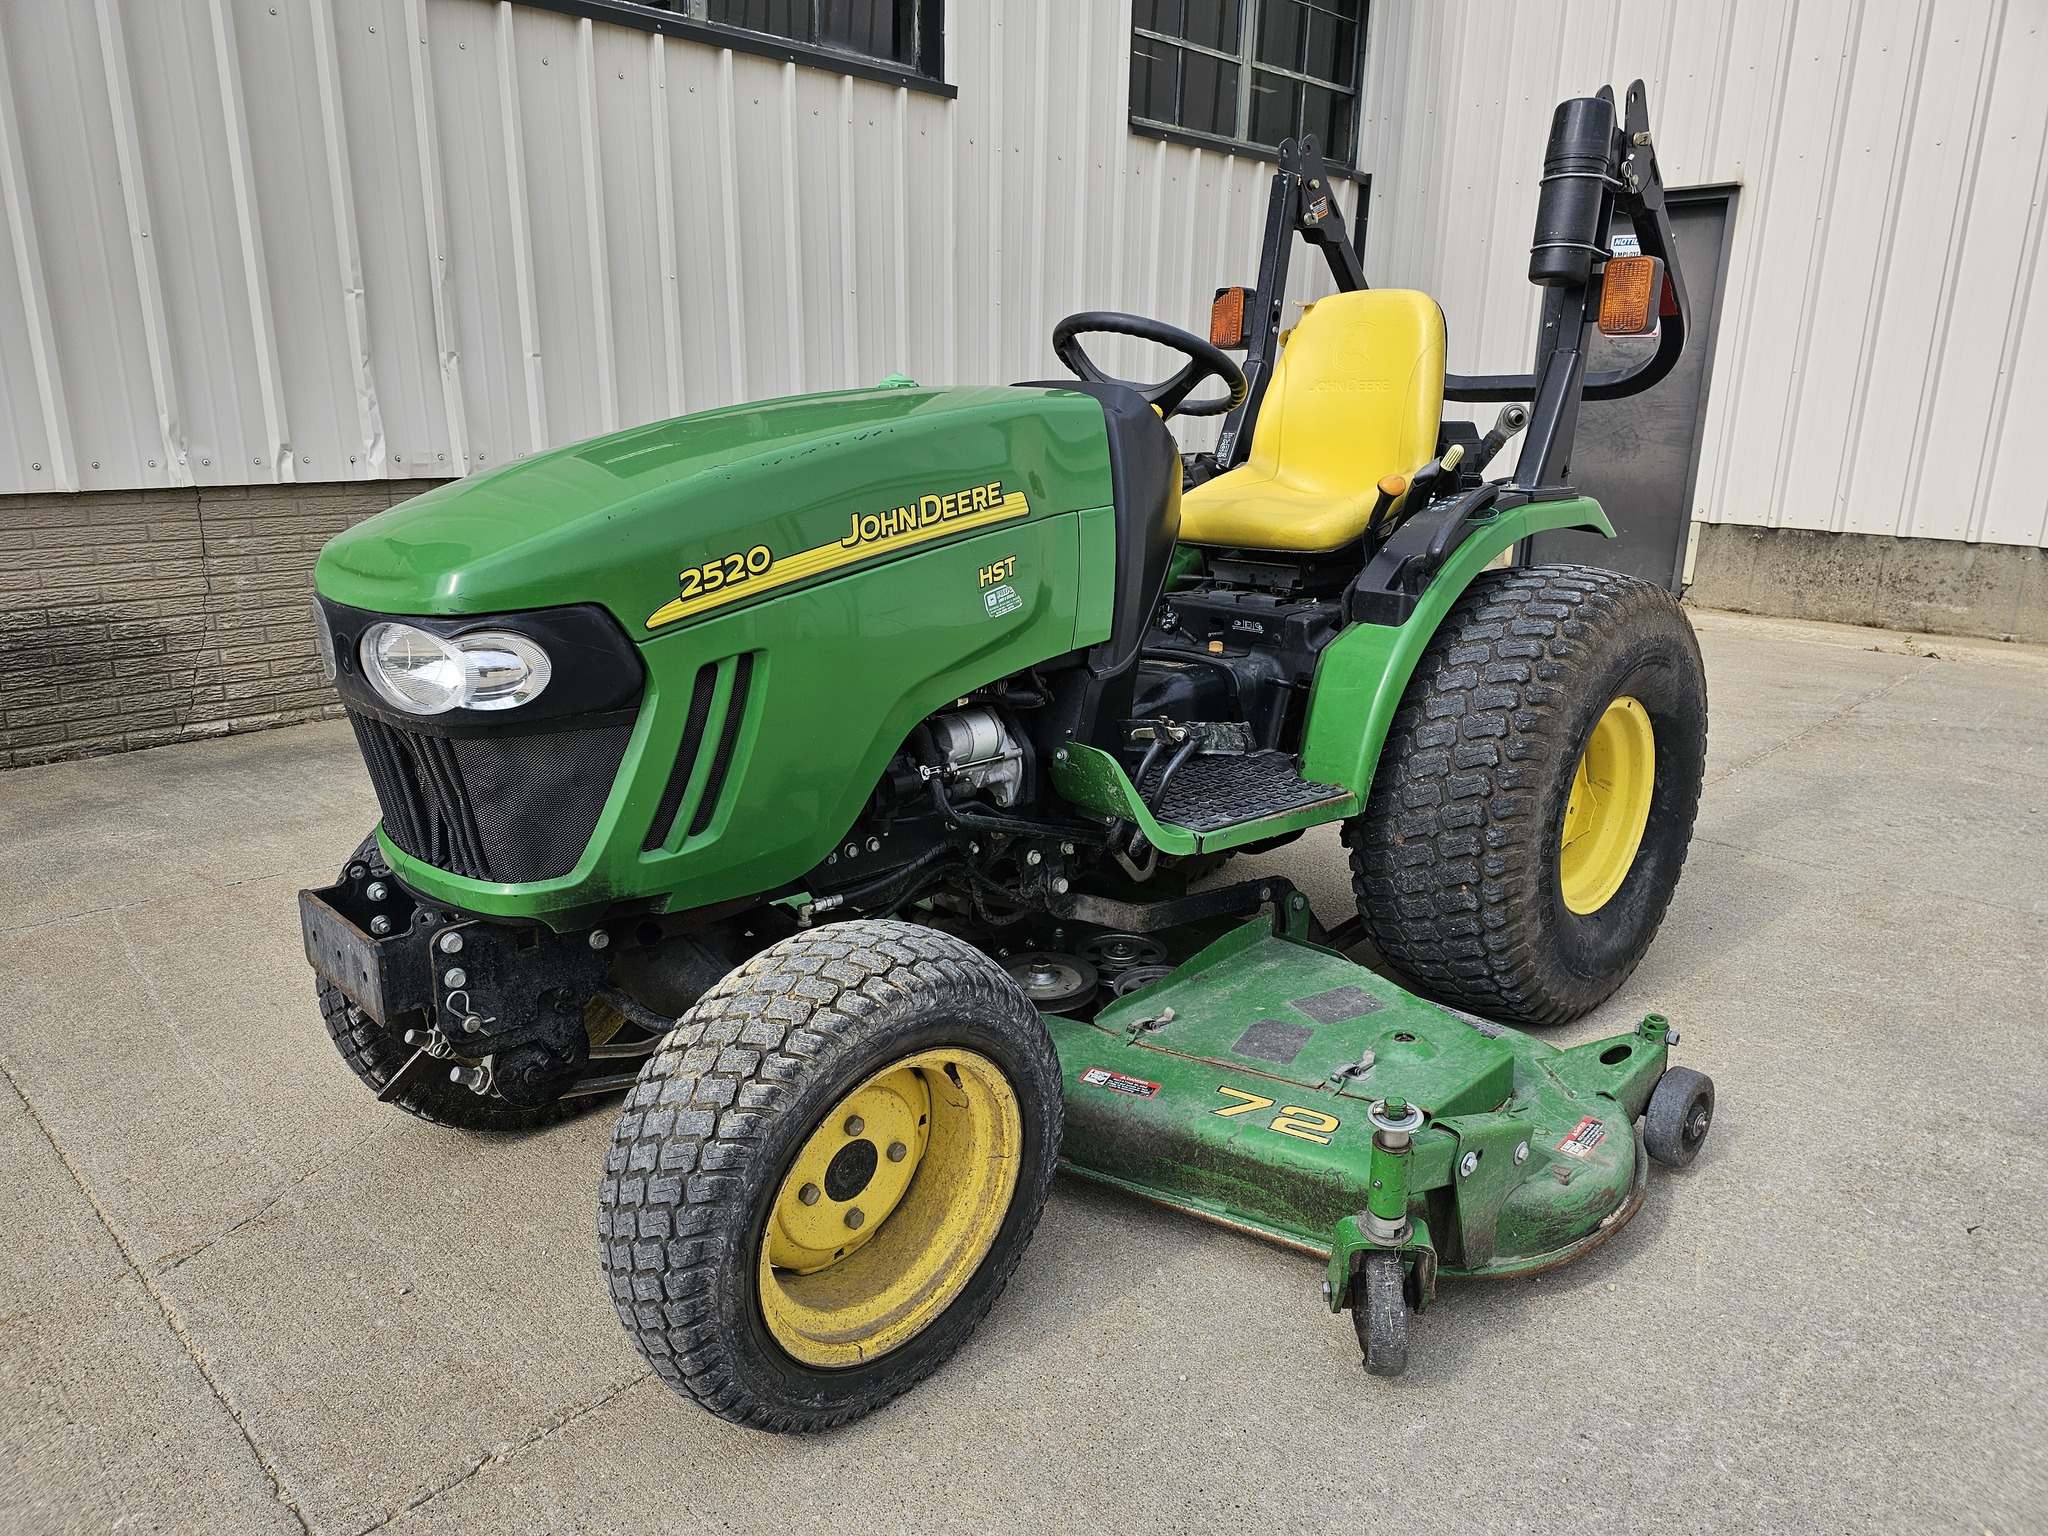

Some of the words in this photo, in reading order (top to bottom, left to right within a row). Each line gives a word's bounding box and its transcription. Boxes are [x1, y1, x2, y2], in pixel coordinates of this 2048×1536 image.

[1308, 379, 1344, 393] JOHN
[1346, 378, 1390, 392] DEERE
[841, 503, 919, 547] JOHN
[919, 481, 1004, 527] DEERE
[679, 544, 773, 602] 2520
[979, 554, 1016, 589] HST
[1209, 1085, 1342, 1146] 72
